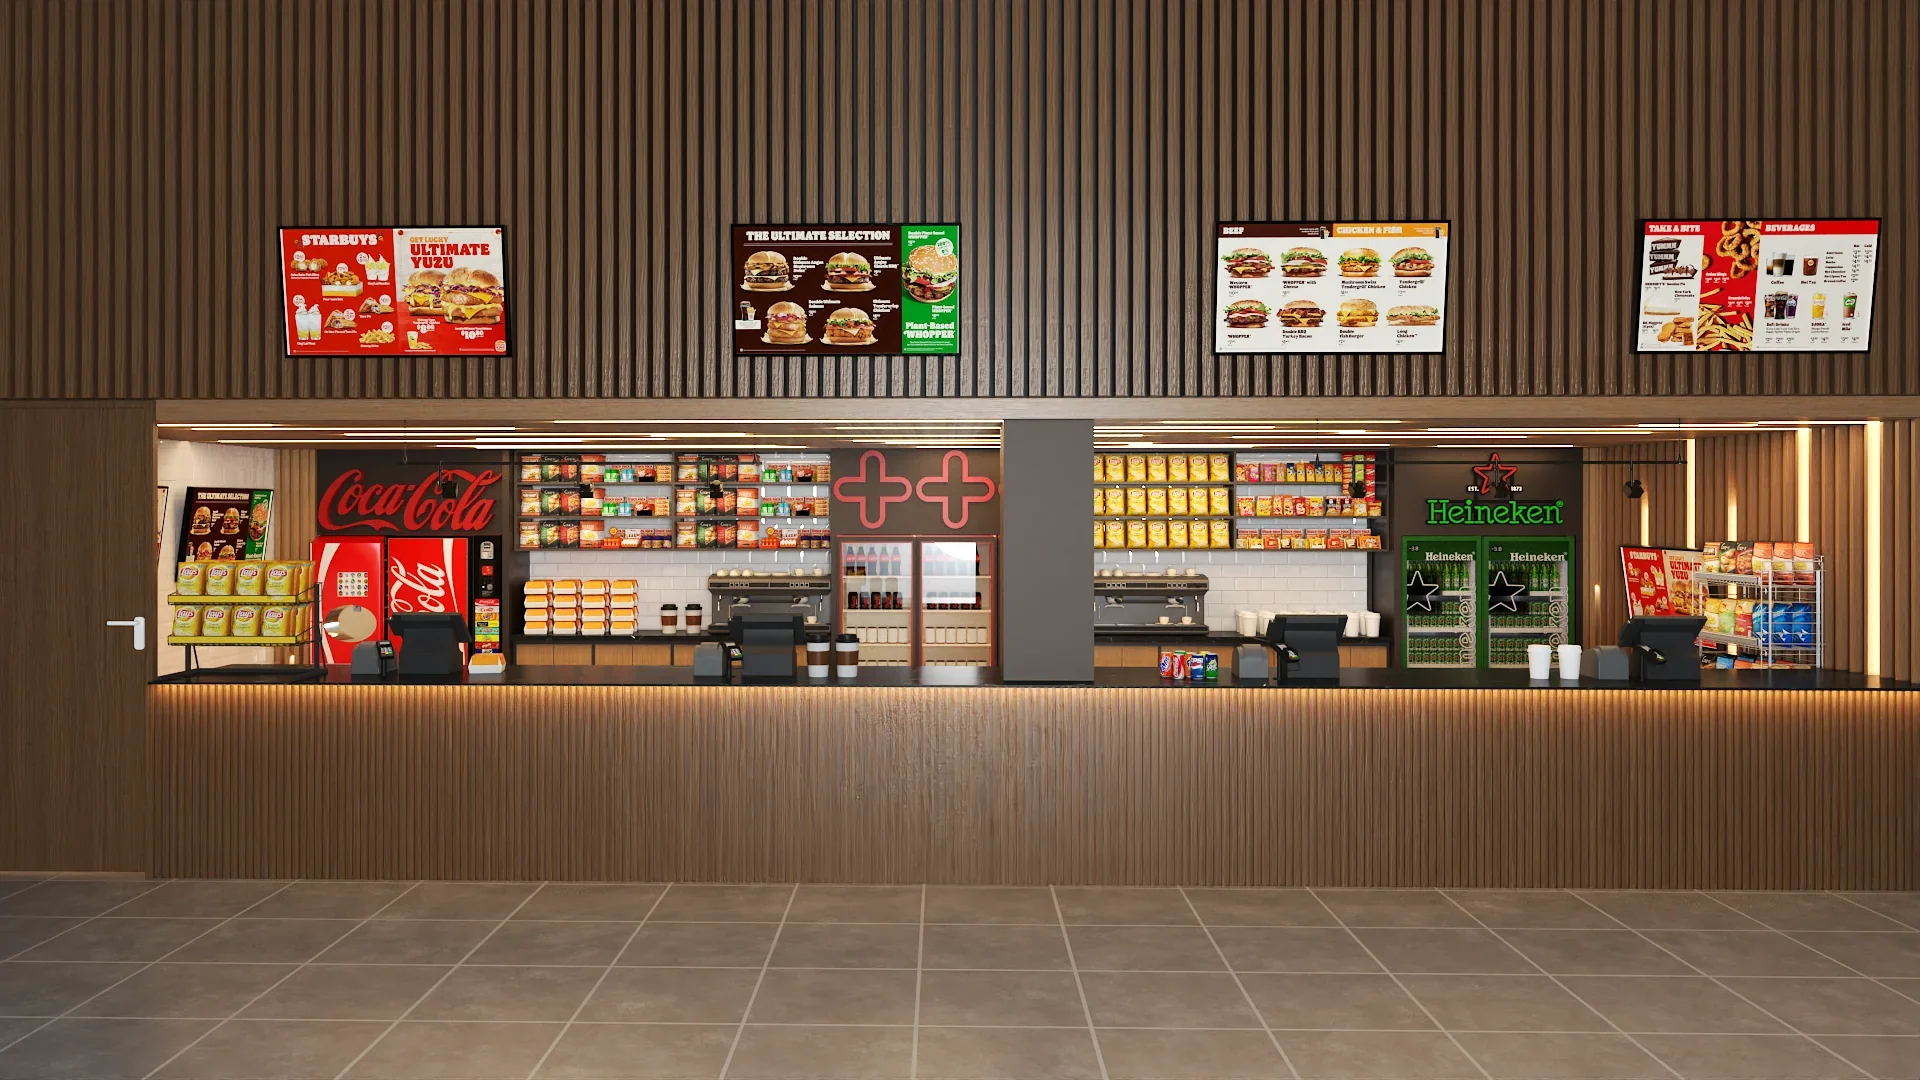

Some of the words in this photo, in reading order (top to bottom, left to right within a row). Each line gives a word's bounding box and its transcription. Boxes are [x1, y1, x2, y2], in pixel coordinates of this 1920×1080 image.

[1337, 226, 1374, 234] CHICKEN
[1376, 226, 1382, 234] &
[1765, 224, 1815, 232] BEVERAGES
[302, 234, 377, 246] STARBUYS
[746, 231, 769, 241] THE
[770, 231, 827, 241] ULTIMATE
[828, 231, 890, 241] SELECTION
[410, 244, 490, 255] ULTIMATE
[411, 257, 453, 268] YUZU
[318, 469, 503, 531] Coca-Cola
[1427, 500, 1563, 524] Heineken
[1426, 552, 1473, 561] Heineken
[1510, 553, 1565, 562] Heineken
[1671, 571, 1688, 580] YUZU
